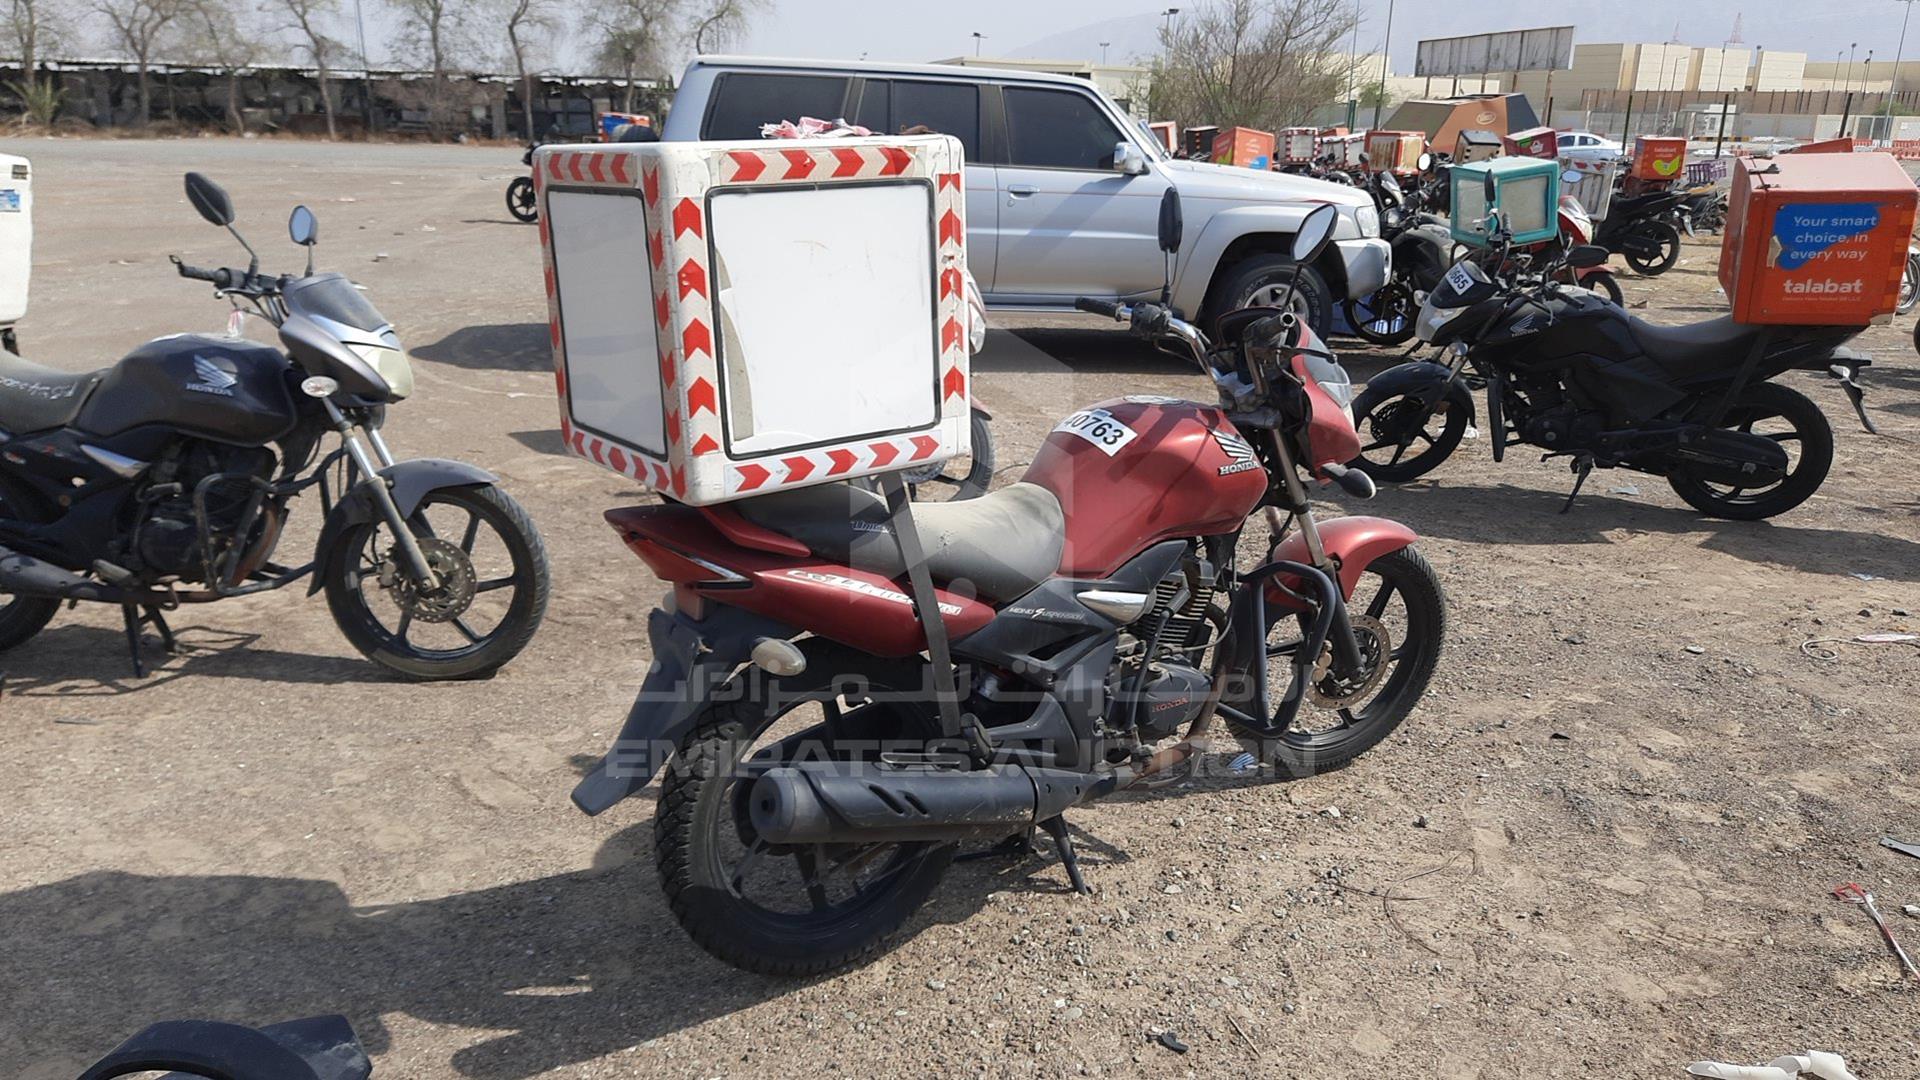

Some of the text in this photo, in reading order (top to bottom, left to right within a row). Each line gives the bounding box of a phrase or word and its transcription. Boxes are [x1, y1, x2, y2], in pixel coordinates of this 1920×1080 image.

[1794, 216, 1878, 227] Your smart
[1795, 232, 1868, 244] choice, in
[1790, 250, 1868, 262] every way
[1783, 279, 1863, 294] talabat
[185, 383, 234, 397] HONDA
